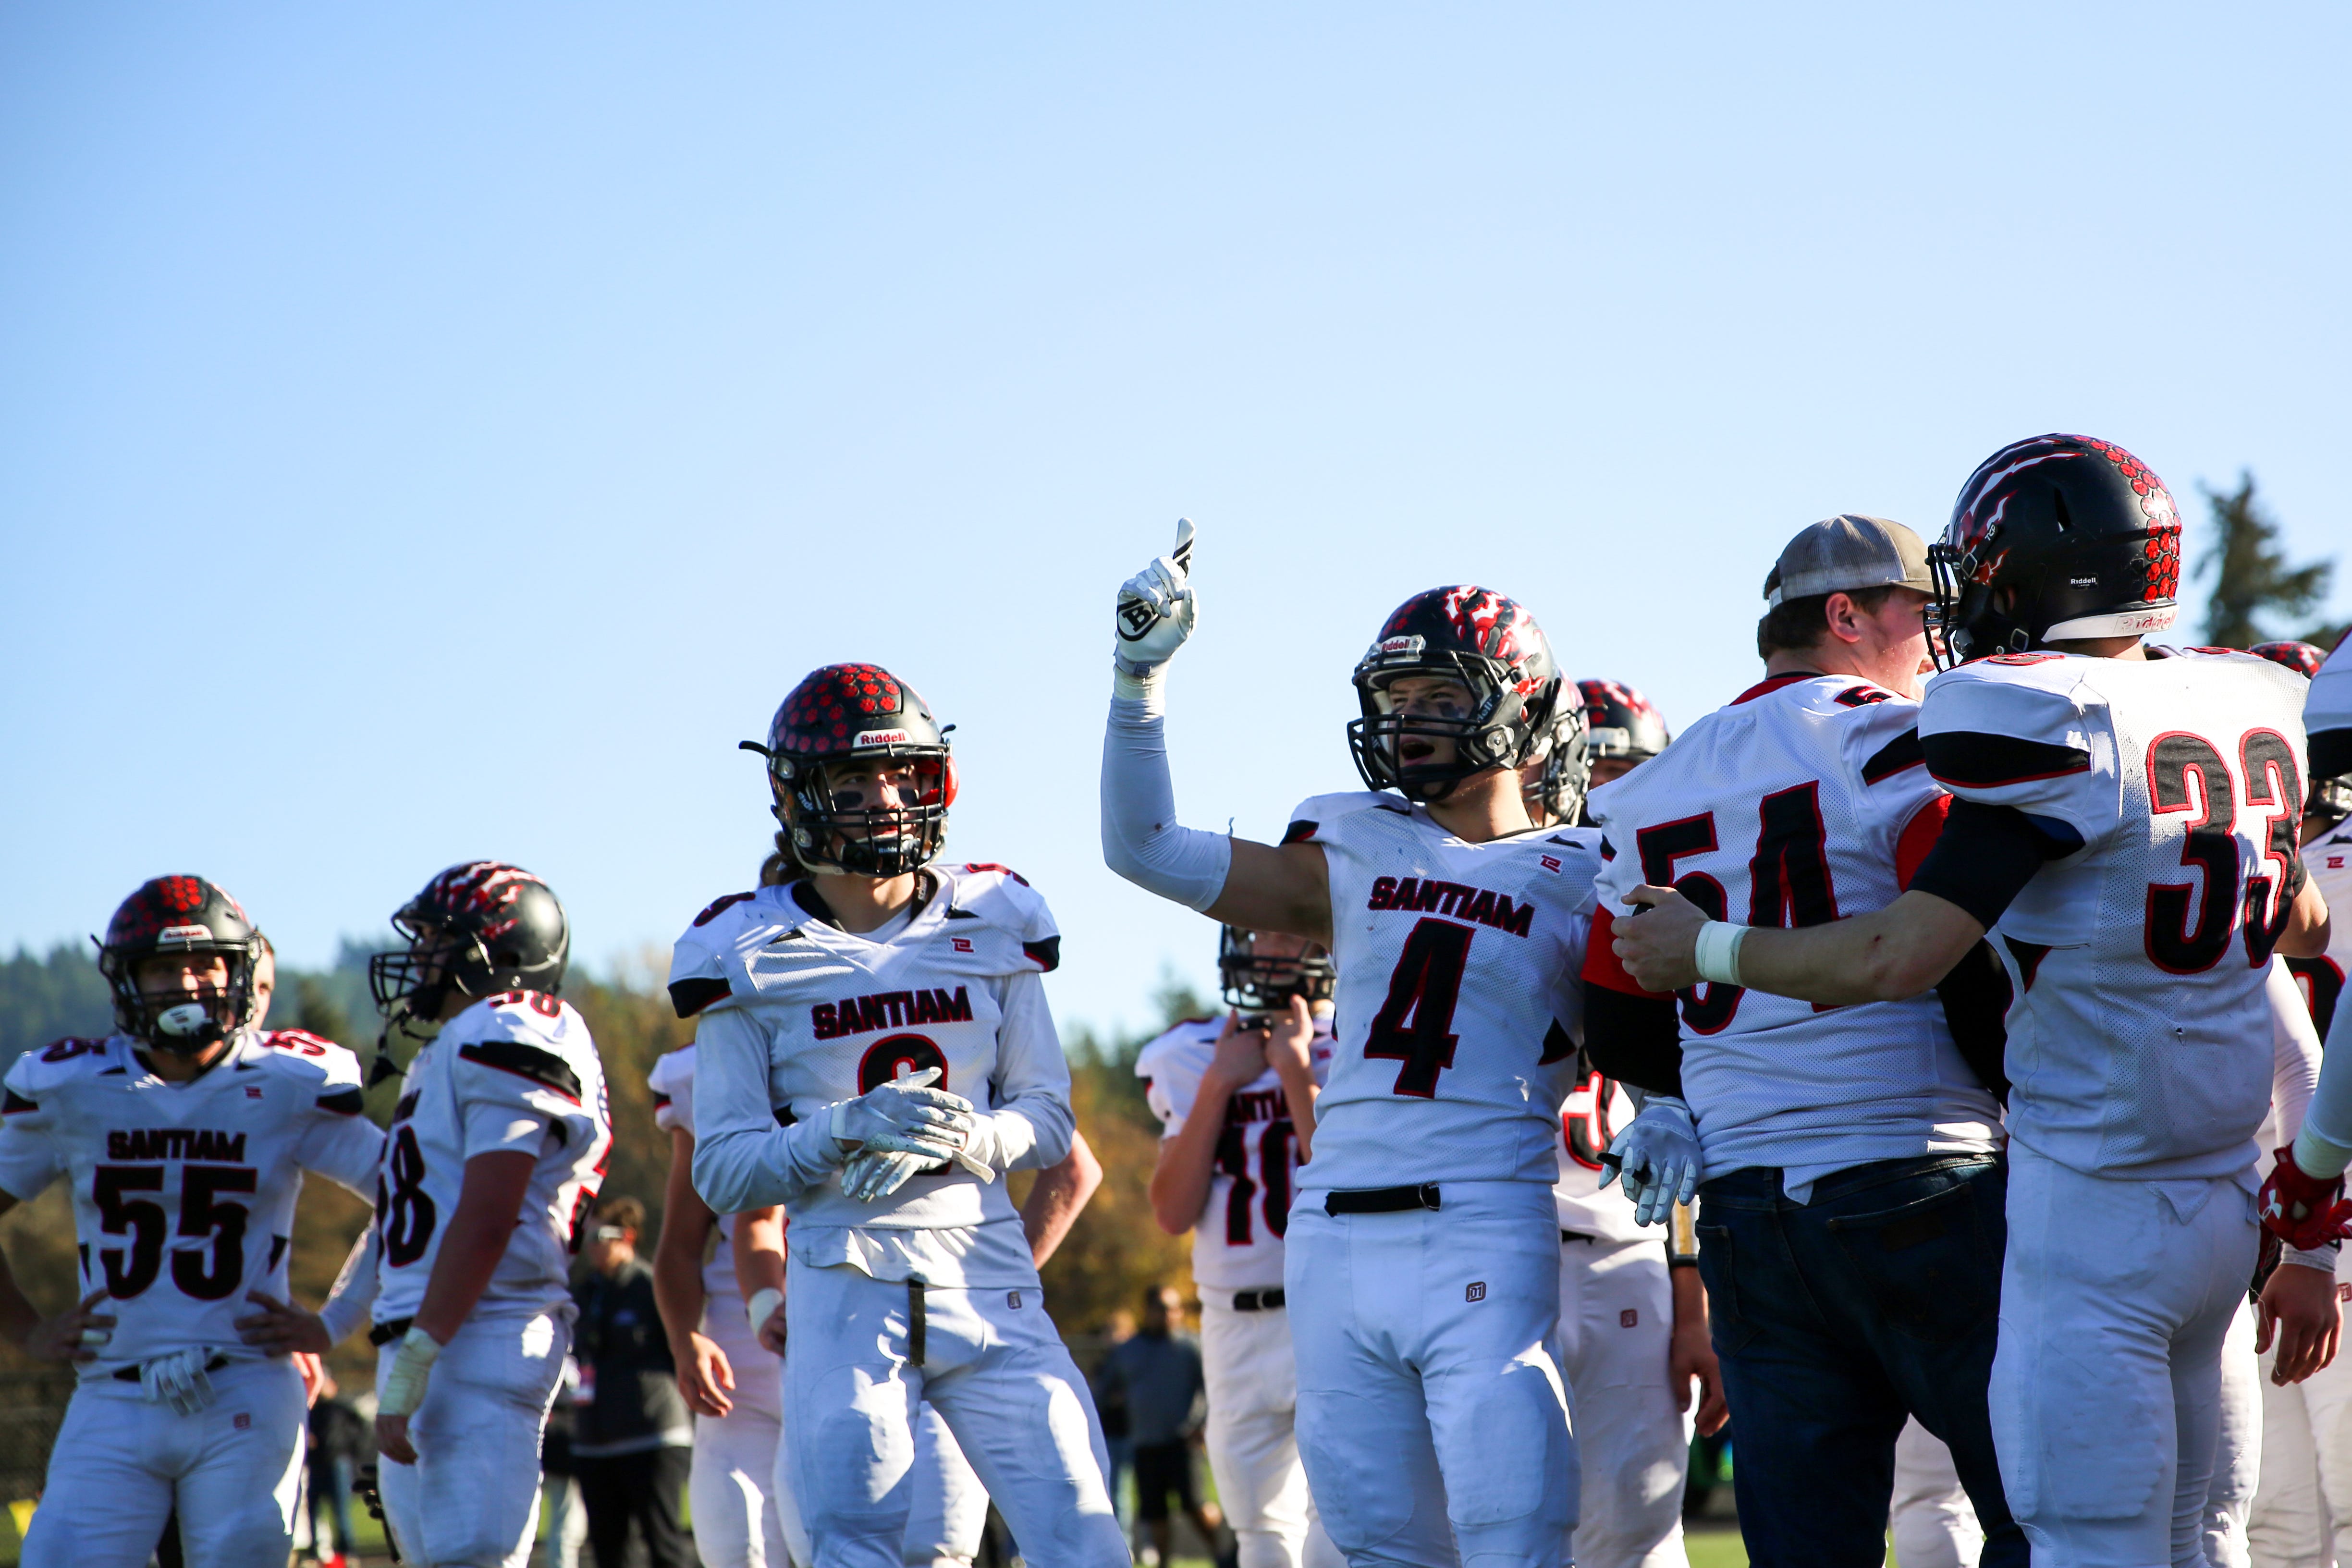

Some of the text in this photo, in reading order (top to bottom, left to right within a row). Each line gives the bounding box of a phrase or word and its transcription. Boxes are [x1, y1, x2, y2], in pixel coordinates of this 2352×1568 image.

[1984, 524, 1996, 541] TCP
[860, 733, 906, 745] Riddell
[2144, 727, 2303, 974] 33
[1367, 876, 1535, 938] SANTIAM
[1636, 779, 1853, 1036] 54
[811, 986, 974, 1040] SANTIAM
[1363, 916, 1477, 1099] 4
[1224, 1088, 1291, 1123] ANTIA
[107, 1128, 247, 1163] SANTIAM
[376, 1125, 436, 1267] 8
[92, 1164, 257, 1302] 55
